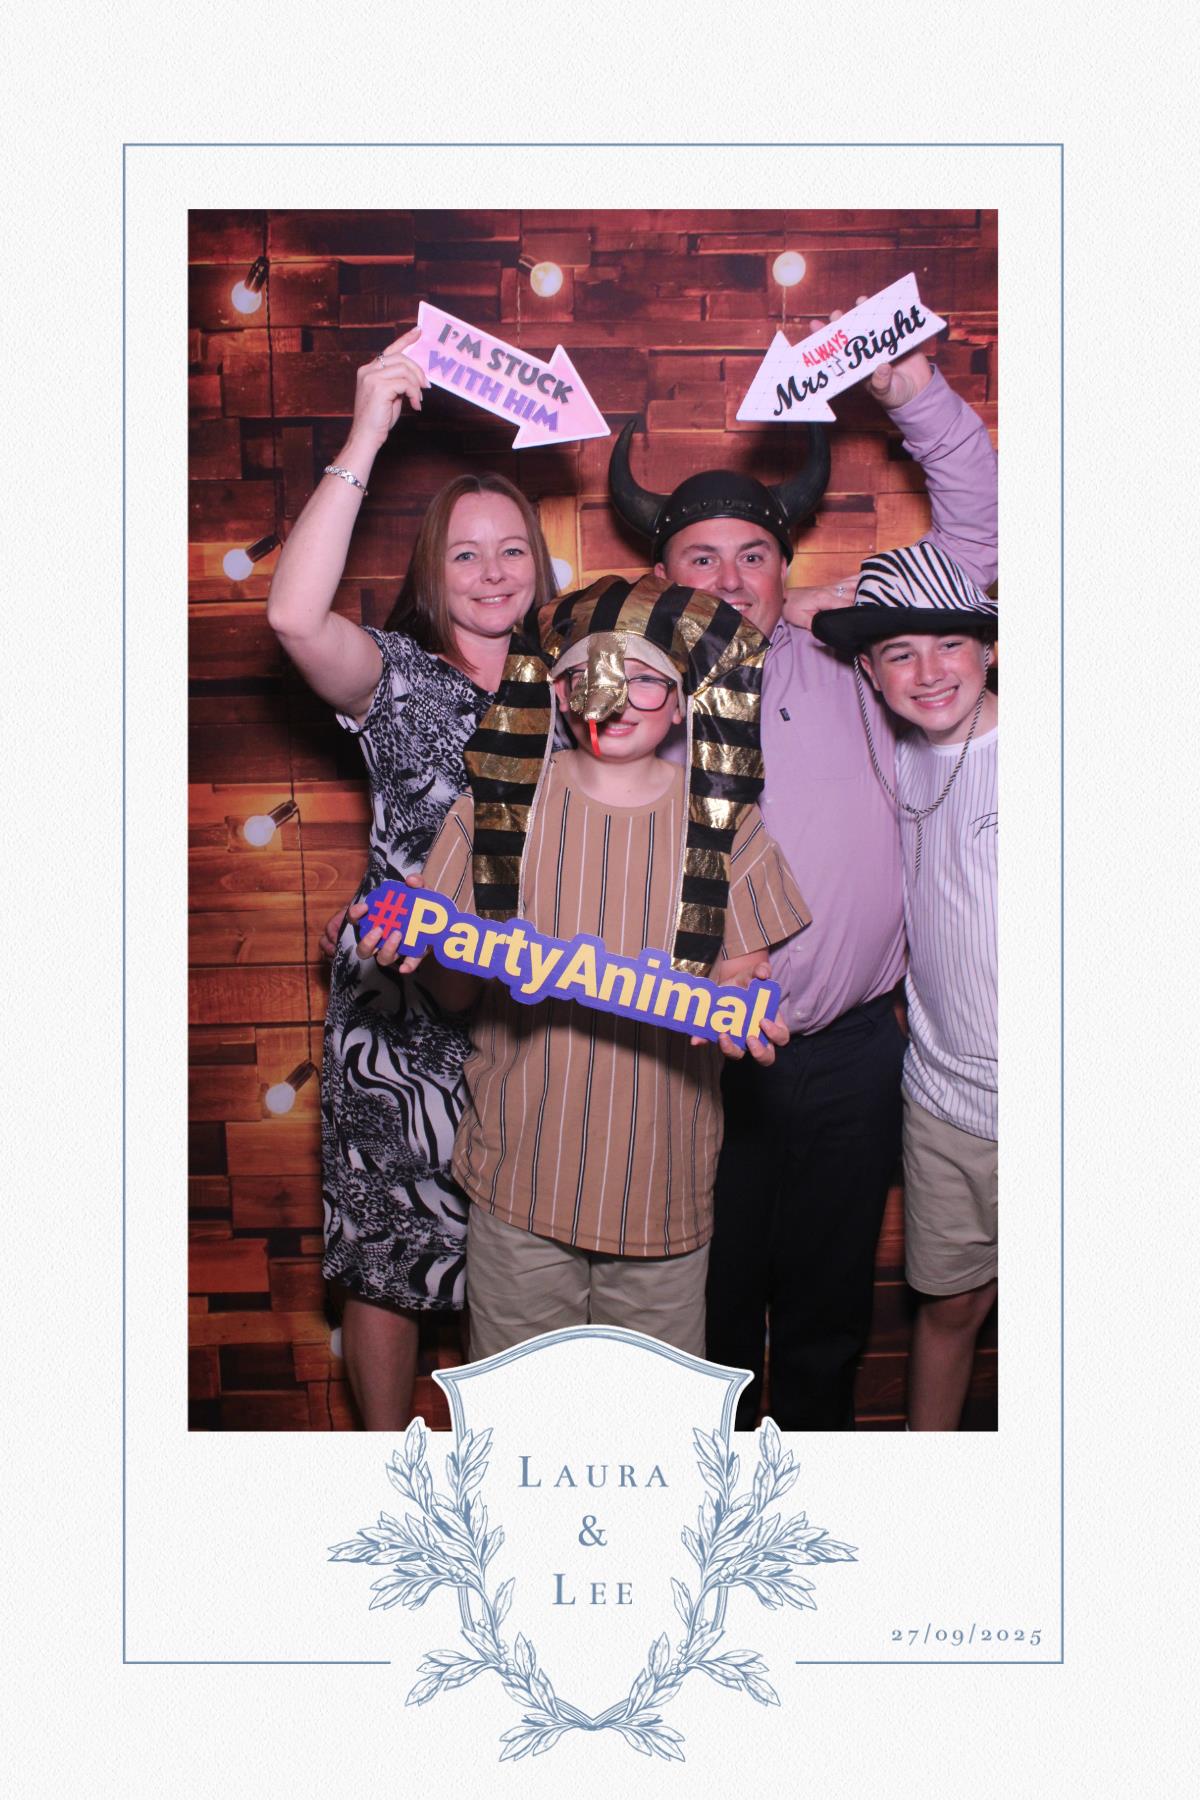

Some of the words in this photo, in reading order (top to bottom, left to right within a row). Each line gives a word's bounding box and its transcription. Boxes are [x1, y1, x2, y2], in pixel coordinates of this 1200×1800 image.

[438, 324, 482, 359] I'M
[487, 347, 573, 404] STUCK
[773, 370, 829, 416] Mrs
[844, 305, 926, 369] Right
[802, 329, 849, 368] ALWAYS
[428, 350, 504, 403] WITH
[502, 389, 559, 432] HIM
[367, 890, 771, 1039] #PartyAnimal
